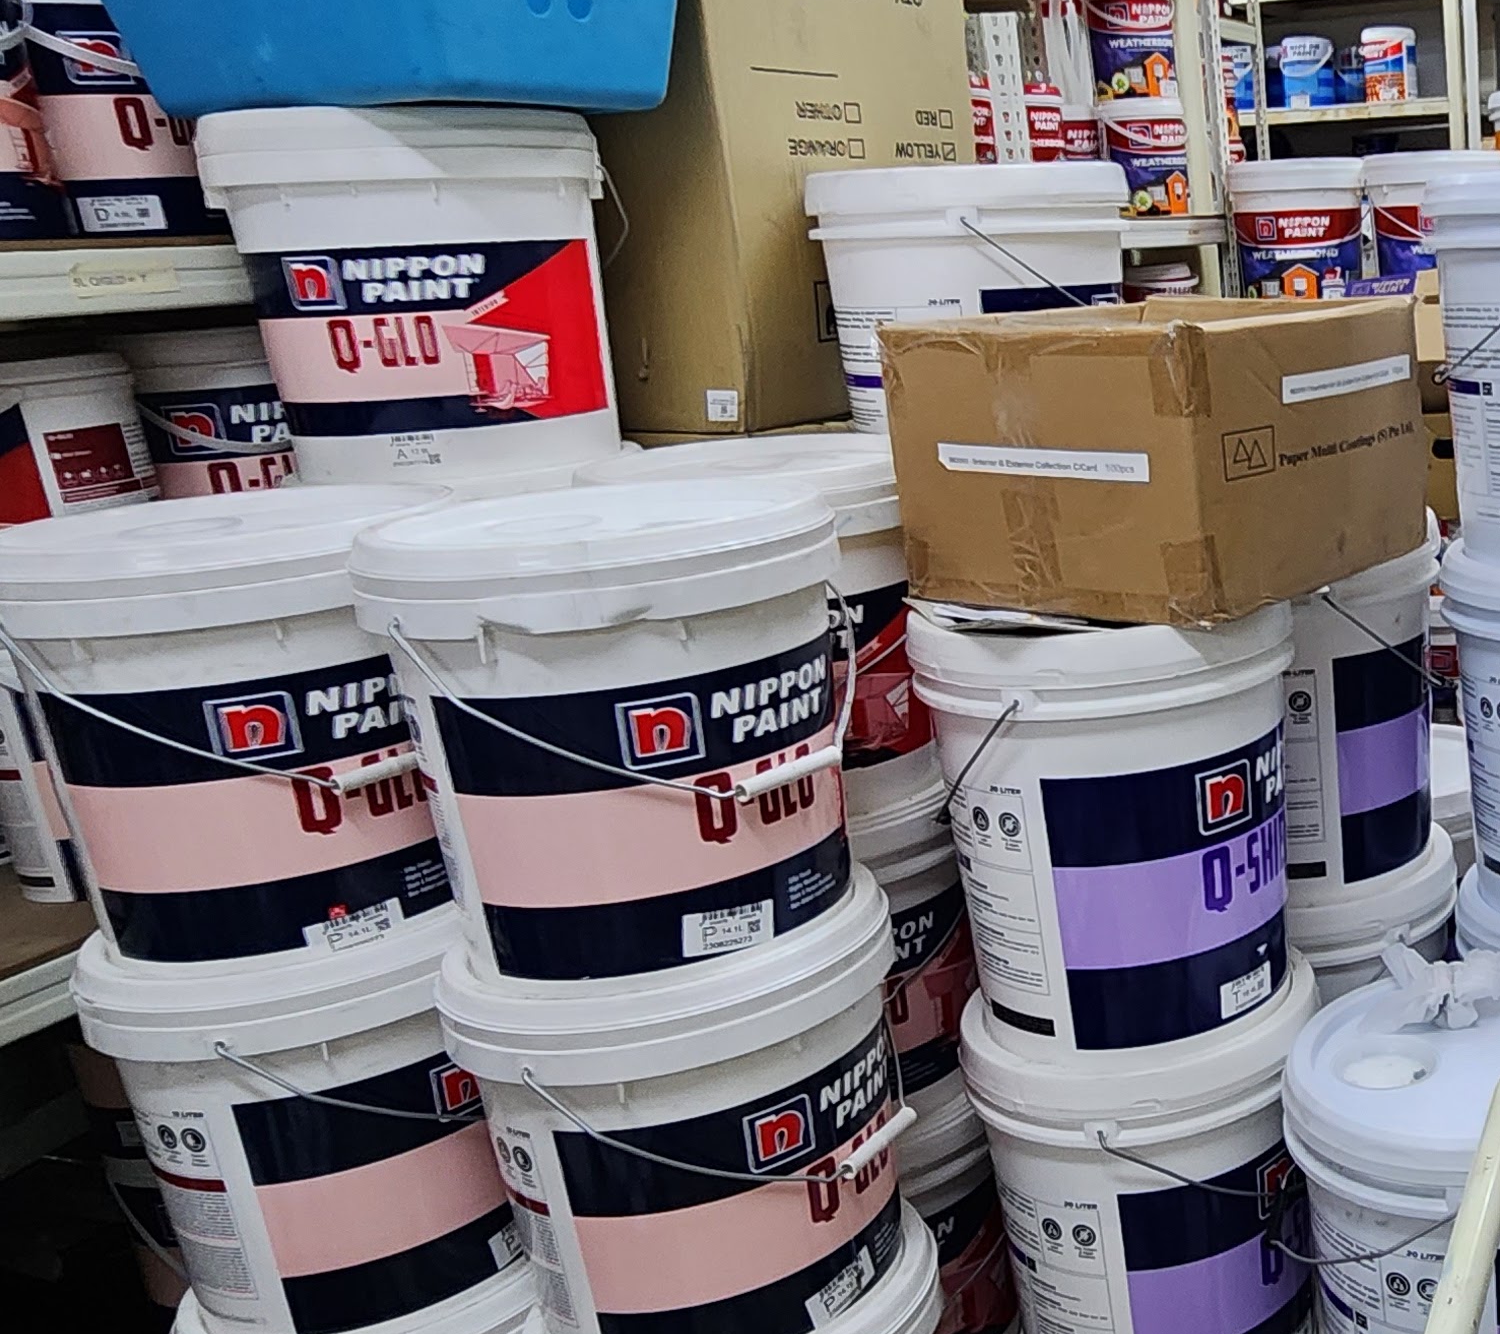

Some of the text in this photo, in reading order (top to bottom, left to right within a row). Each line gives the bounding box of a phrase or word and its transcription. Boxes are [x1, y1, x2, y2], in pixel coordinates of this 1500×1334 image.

[795, 100, 938, 127] RED OTHER
[787, 138, 945, 160] YELLOW ORANGE
[1277, 215, 1331, 229] NIPPON
[1284, 227, 1327, 239] PAINT
[341, 253, 486, 281] NIPPON
[361, 277, 472, 304] PAINT
[326, 316, 442, 374] Q-GLO
[1278, 450, 1310, 468] Paper
[306, 673, 398, 716] NIP
[710, 654, 828, 719] NIPPON
[332, 704, 401, 739] PAI
[732, 689, 823, 744] PAINT
[1000, 786, 1022, 796] LITER
[1074, 1201, 1099, 1211] LITER
